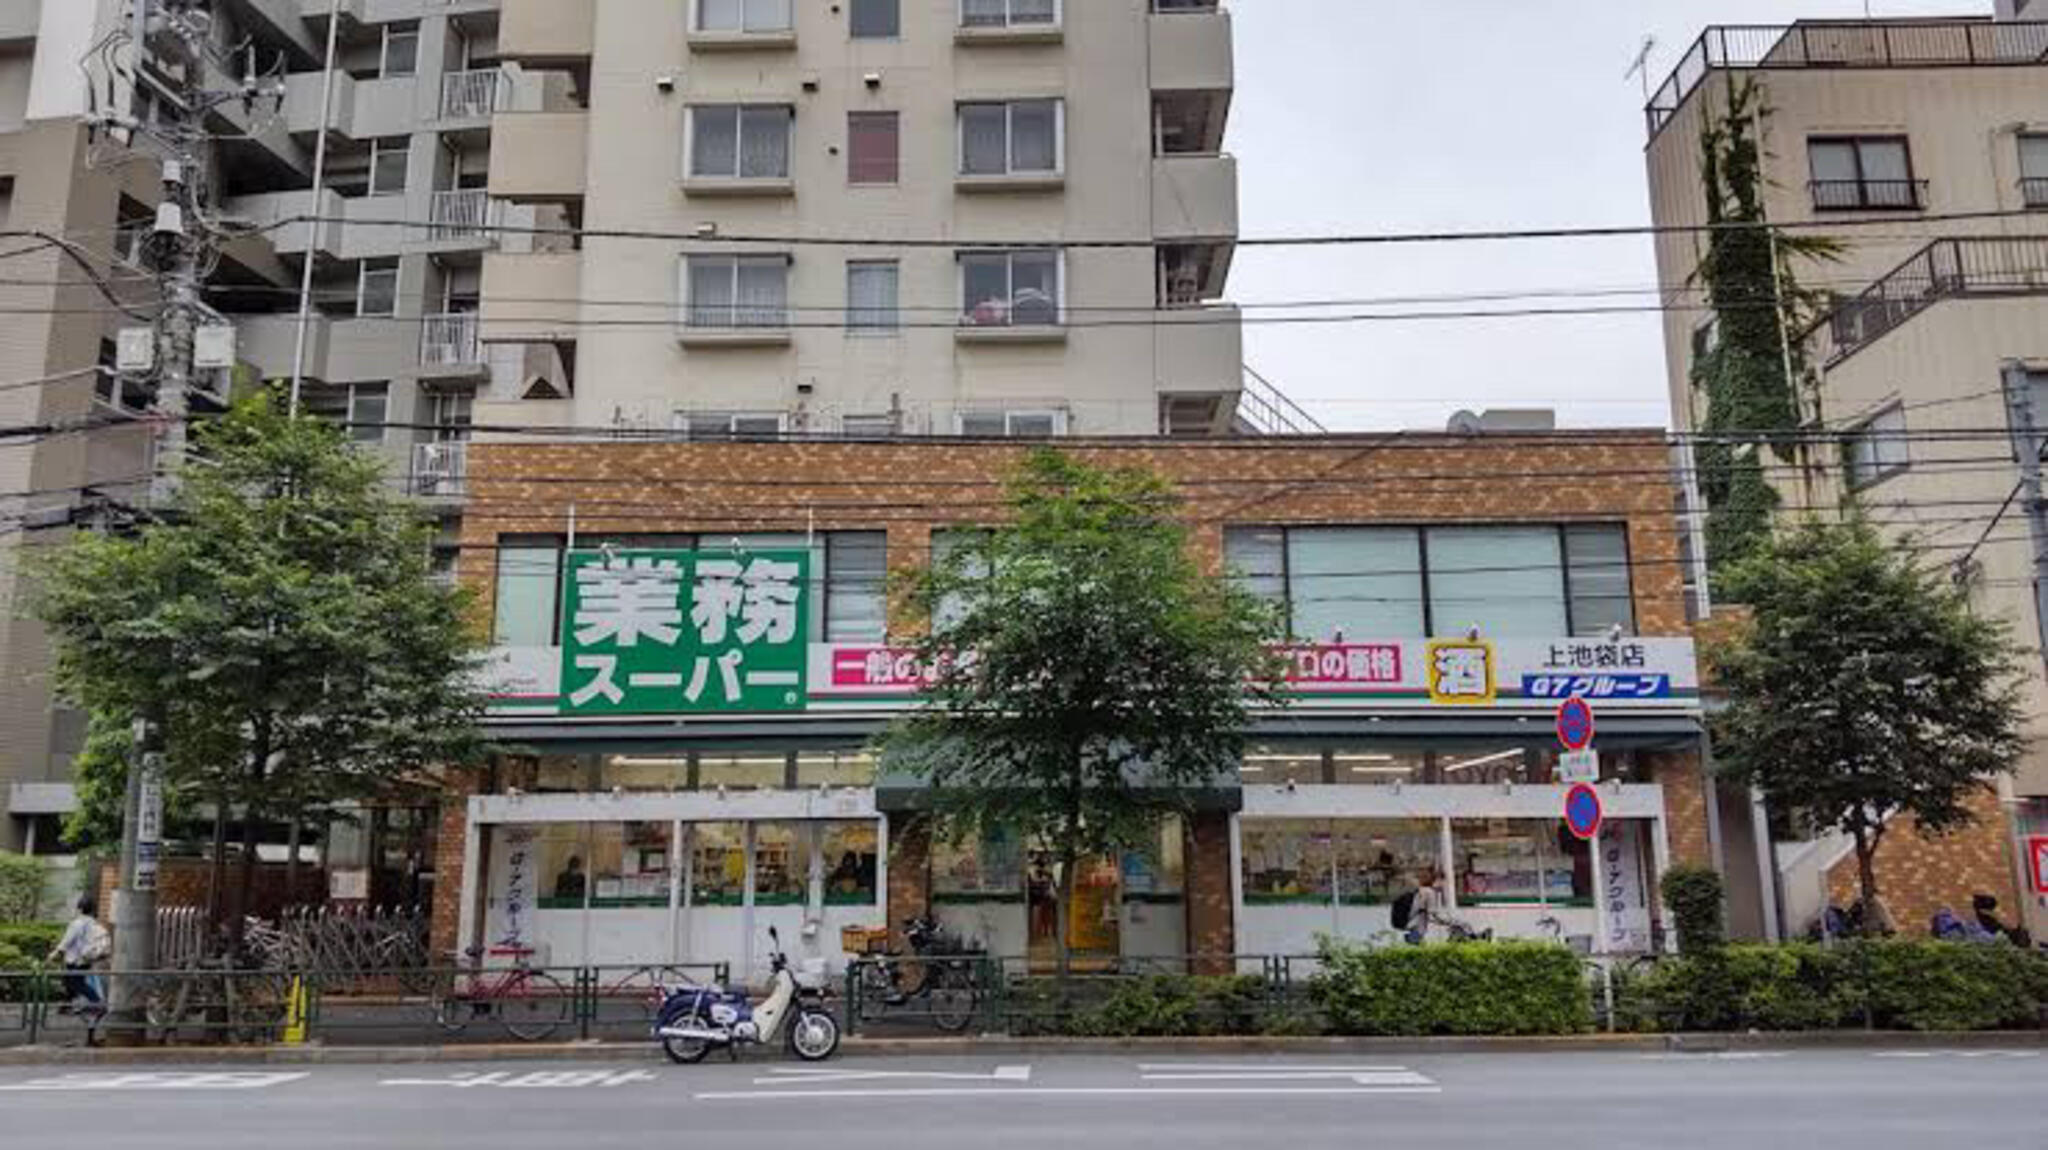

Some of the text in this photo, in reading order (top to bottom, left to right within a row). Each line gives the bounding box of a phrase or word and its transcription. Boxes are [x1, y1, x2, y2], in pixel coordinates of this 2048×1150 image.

[573, 557, 800, 646] 業務
[569, 649, 799, 707] スーパー
[1434, 647, 1487, 695] 酒
[1543, 644, 1645, 668] 上池袋店
[1531, 675, 1661, 696] G7グループ
